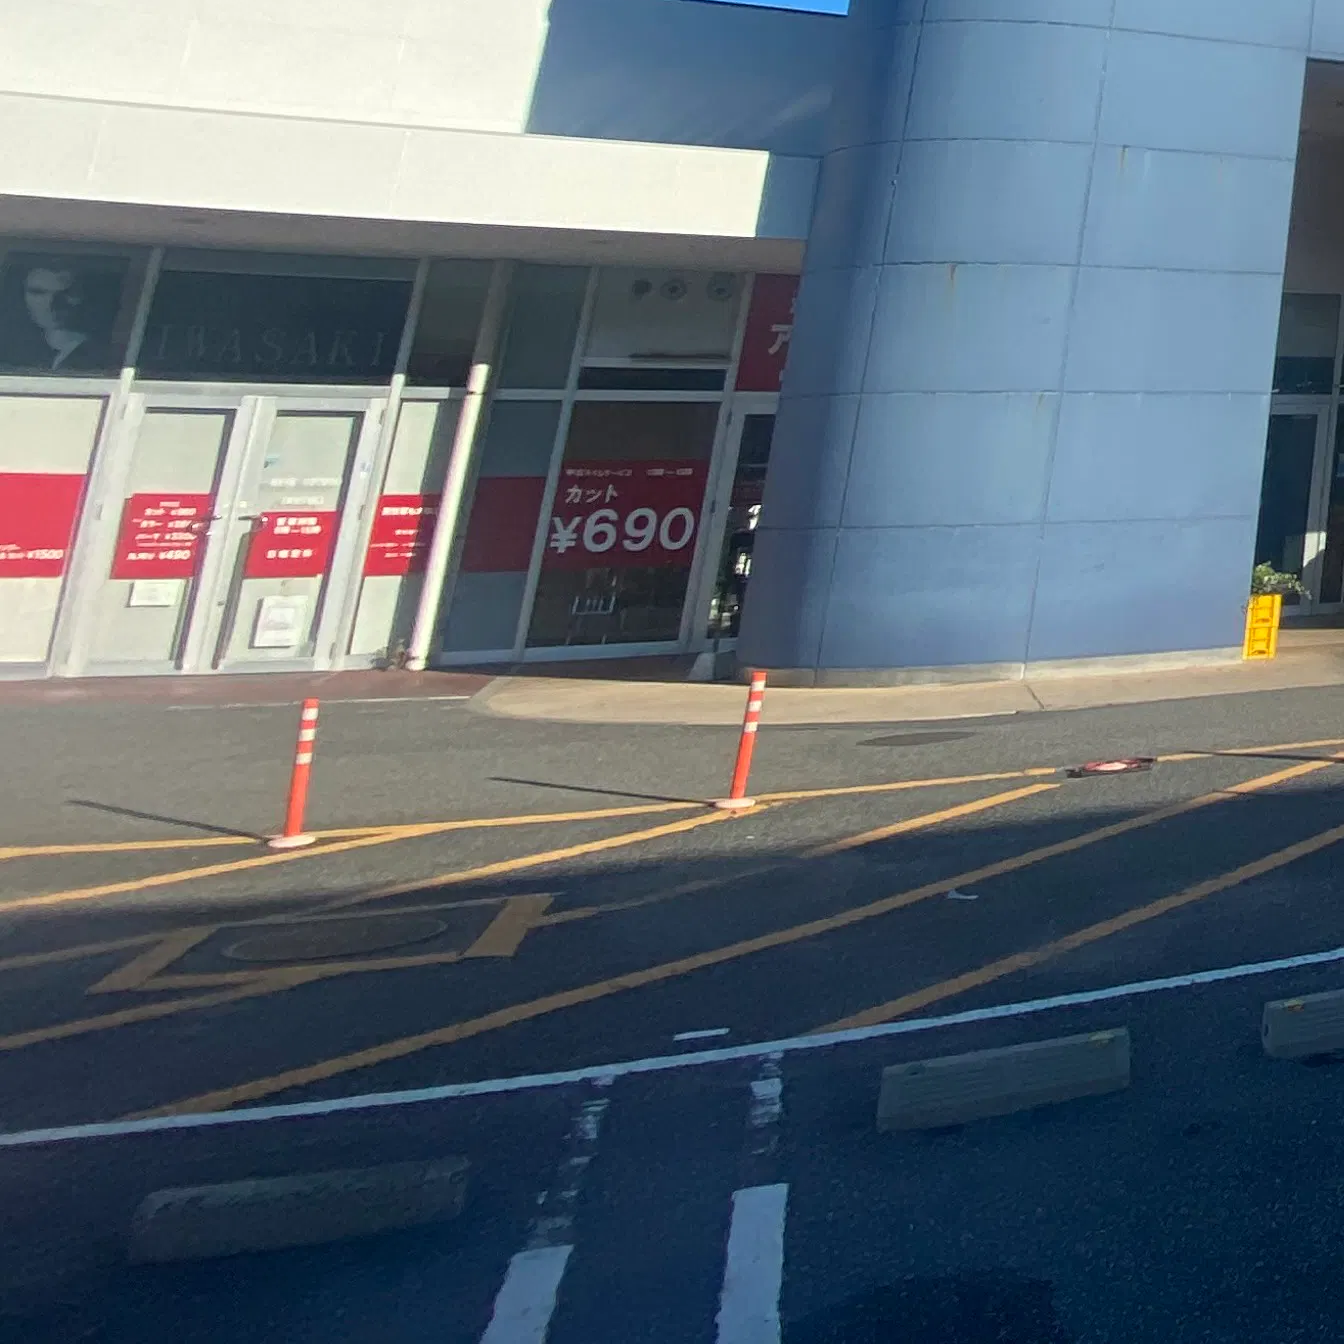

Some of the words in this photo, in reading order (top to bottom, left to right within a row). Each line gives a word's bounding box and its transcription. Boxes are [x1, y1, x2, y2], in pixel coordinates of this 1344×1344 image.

[565, 484, 618, 504] カット
[550, 507, 695, 553] ¥690
